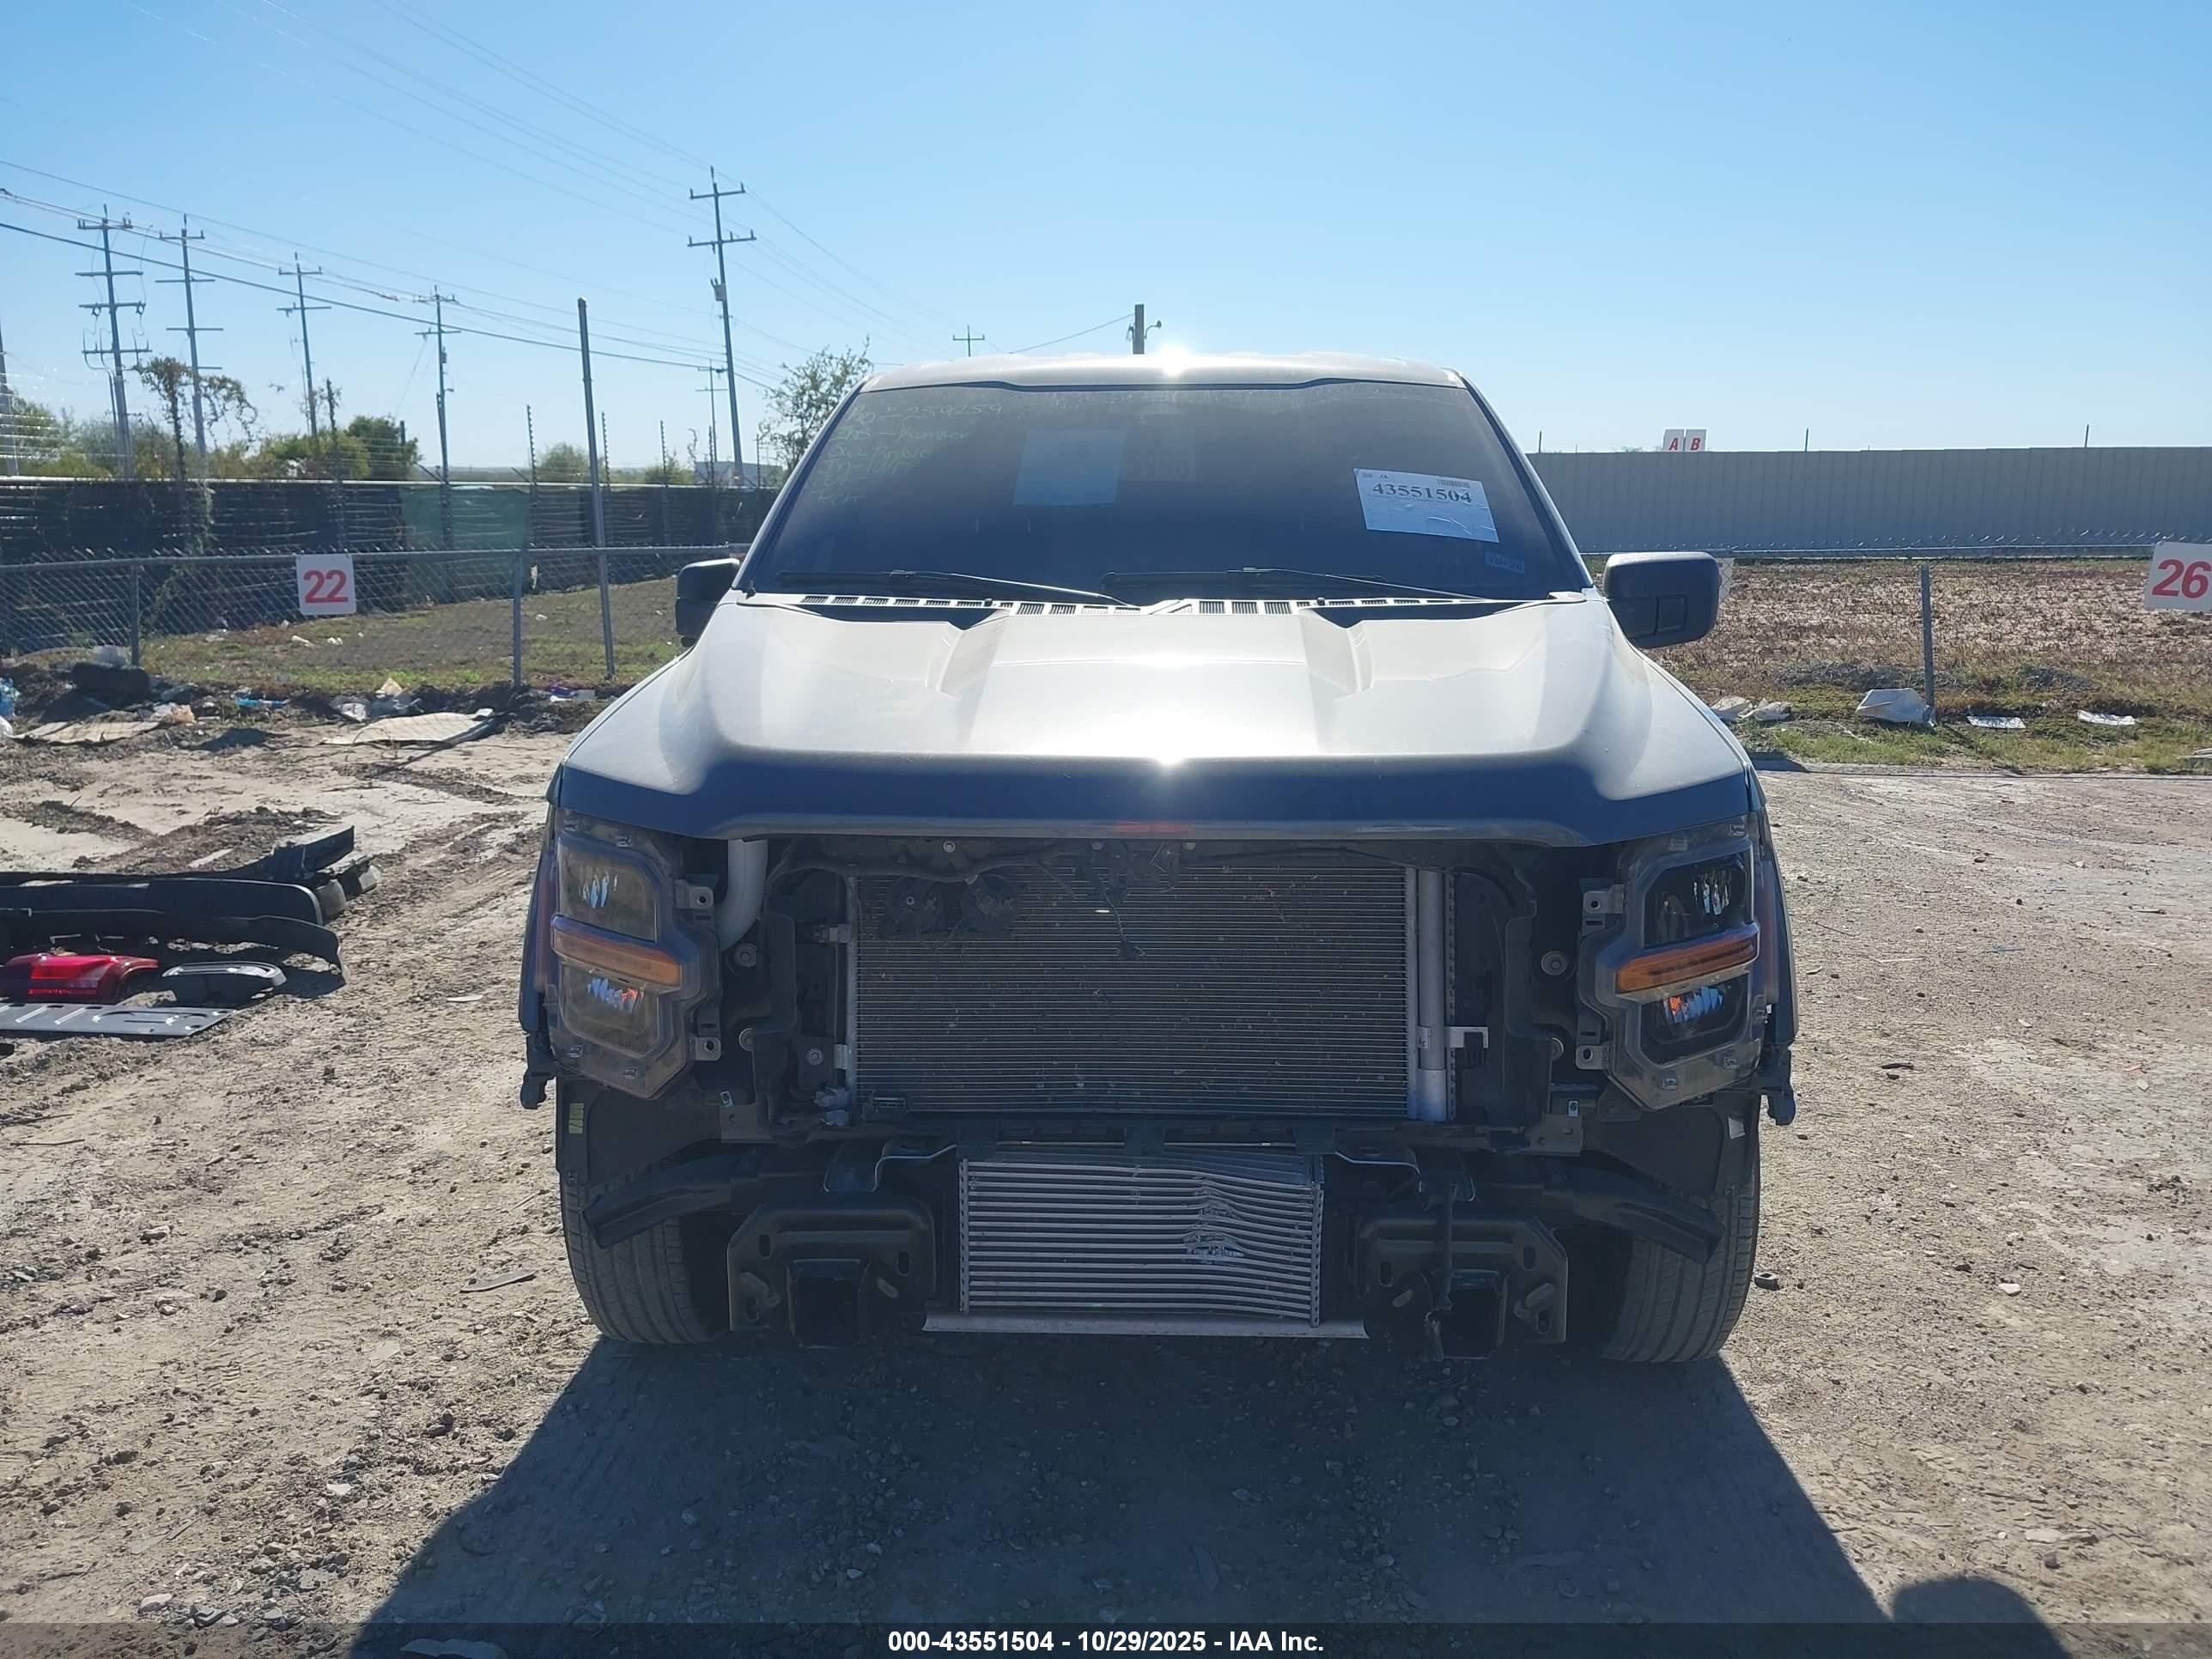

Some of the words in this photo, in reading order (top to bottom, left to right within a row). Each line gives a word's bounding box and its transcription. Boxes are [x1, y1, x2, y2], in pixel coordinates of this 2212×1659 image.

[1668, 437, 1679, 450] A
[1690, 437, 1701, 450] B
[1372, 483, 1473, 503] 43551504
[303, 569, 349, 604] 22
[2152, 559, 2212, 599] 26
